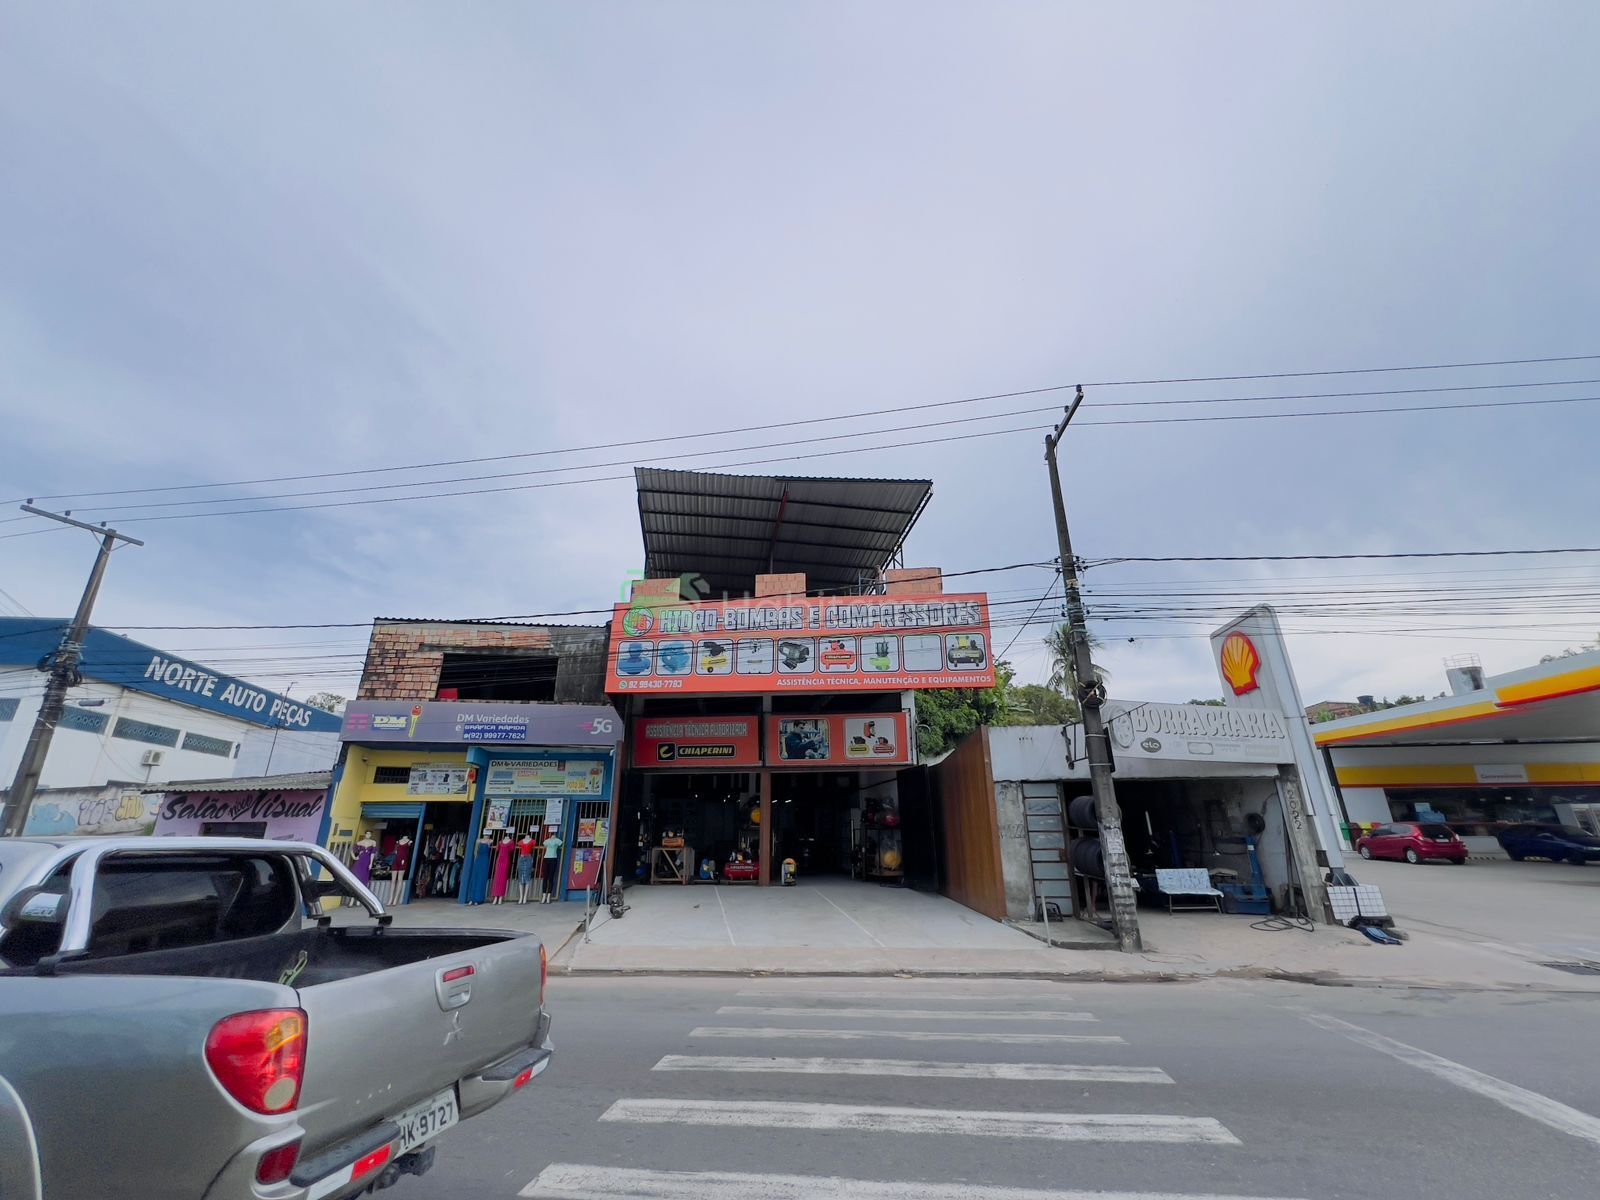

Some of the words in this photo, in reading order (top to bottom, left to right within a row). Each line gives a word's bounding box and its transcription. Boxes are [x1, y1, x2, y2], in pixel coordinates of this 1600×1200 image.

[660, 607, 803, 632] HIDRO-BOMBAS
[808, 605, 820, 629] E
[825, 602, 981, 628] COMPRESSORES
[777, 677, 824, 686] ASSISTÊNCIA
[864, 675, 919, 685] MANUTENÇÃO
[922, 676, 927, 684] E
[928, 675, 991, 684] EQUIPAMENTOS
[144, 655, 218, 697] NORTE
[220, 683, 267, 713] AUTO
[269, 698, 312, 727] PEÇAS
[457, 713, 474, 722] DM
[476, 713, 530, 724] Variedades
[1132, 706, 1286, 739] BORRACHARIA
[590, 718, 612, 735] 5G
[469, 732, 482, 740] (92)
[679, 747, 733, 755] CHIAPERINI
[1142, 741, 1160, 749] elo
[162, 794, 227, 820] Salão
[250, 791, 324, 819] Visual
